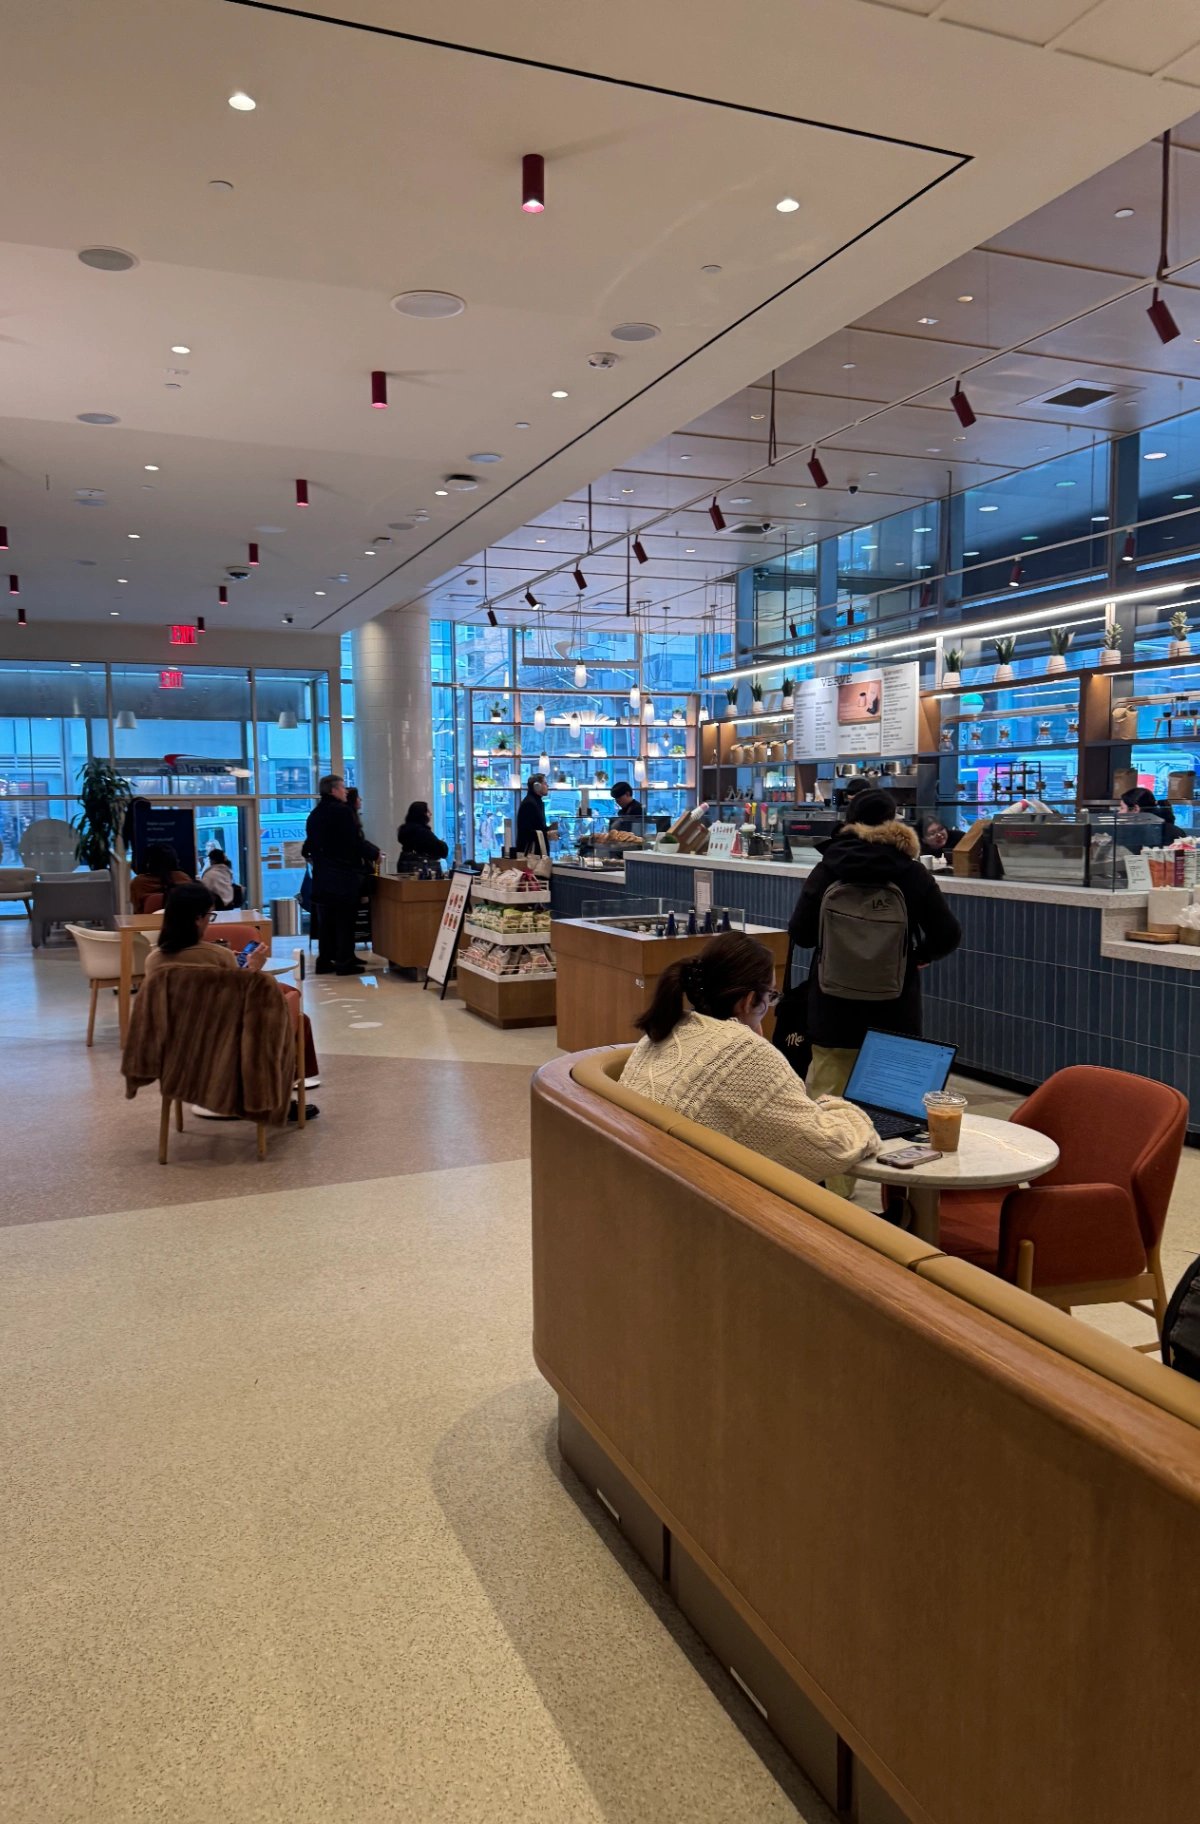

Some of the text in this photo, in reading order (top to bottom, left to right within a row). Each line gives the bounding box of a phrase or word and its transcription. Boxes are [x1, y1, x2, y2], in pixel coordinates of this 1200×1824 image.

[171, 626, 196, 643] EXIT
[821, 674, 853, 687] VERVE
[271, 828, 306, 838] HENR
